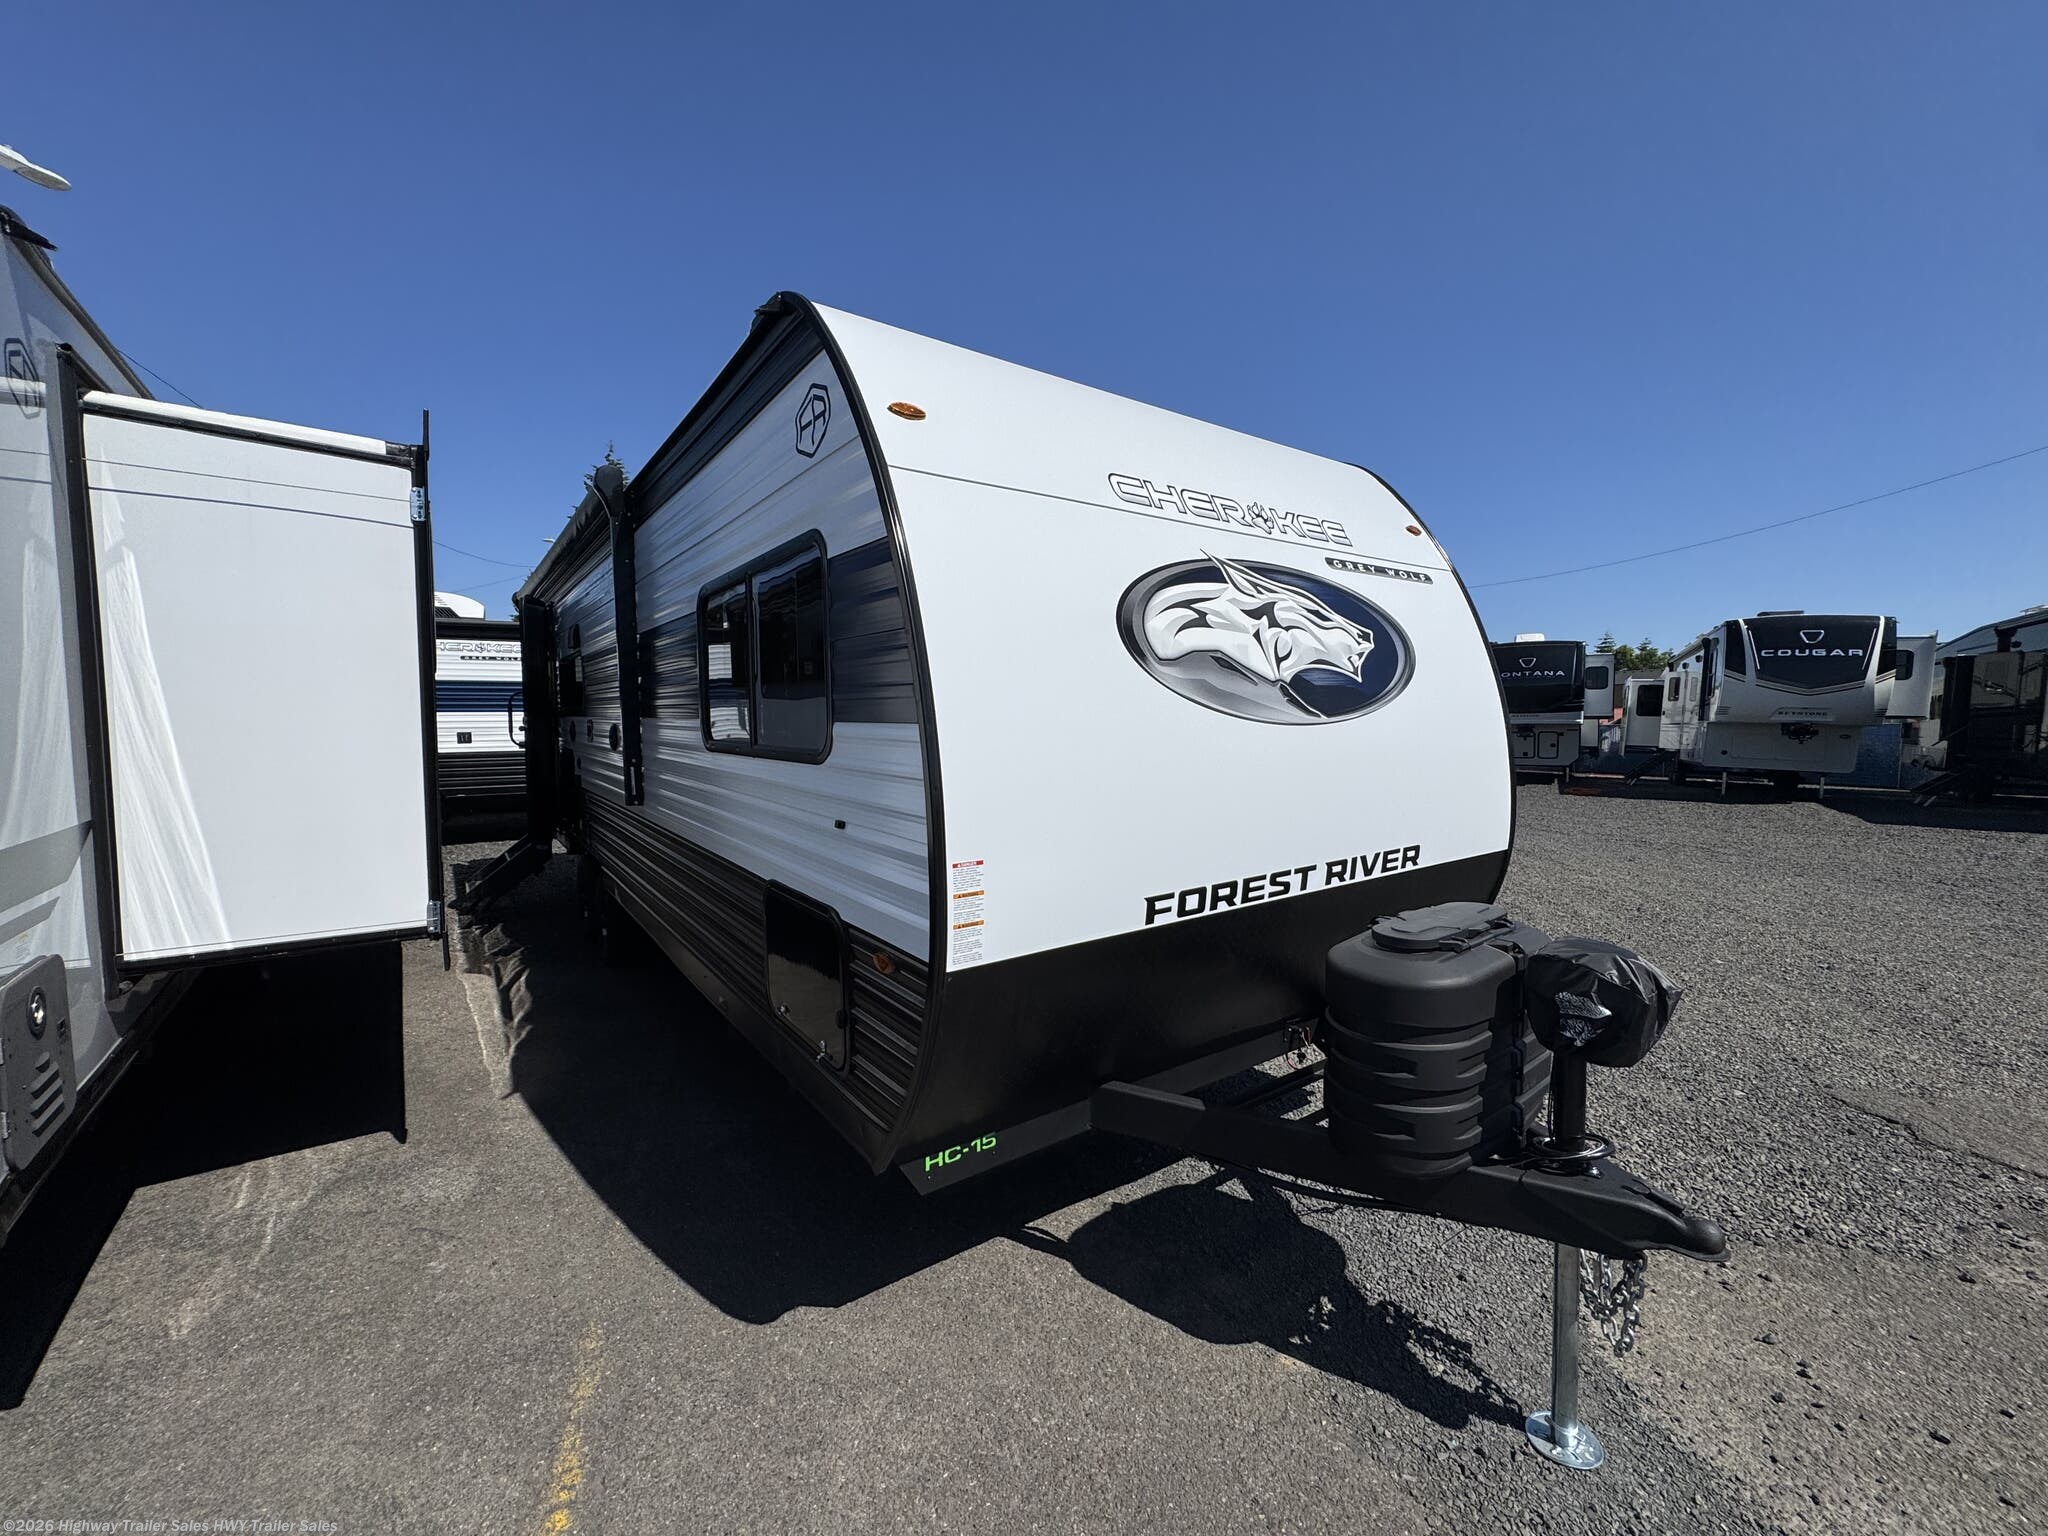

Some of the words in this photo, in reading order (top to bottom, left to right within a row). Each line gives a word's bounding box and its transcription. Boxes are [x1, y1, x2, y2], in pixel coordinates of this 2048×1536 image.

[1333, 559, 1376, 574] GREY
[1385, 568, 1427, 582] WOLF
[1761, 648, 1864, 657] COUGAR
[1501, 670, 1565, 678] ONTANA
[1144, 864, 1317, 925] FOREST
[1325, 845, 1420, 886] RIVER
[925, 1132, 997, 1172] HC-15
